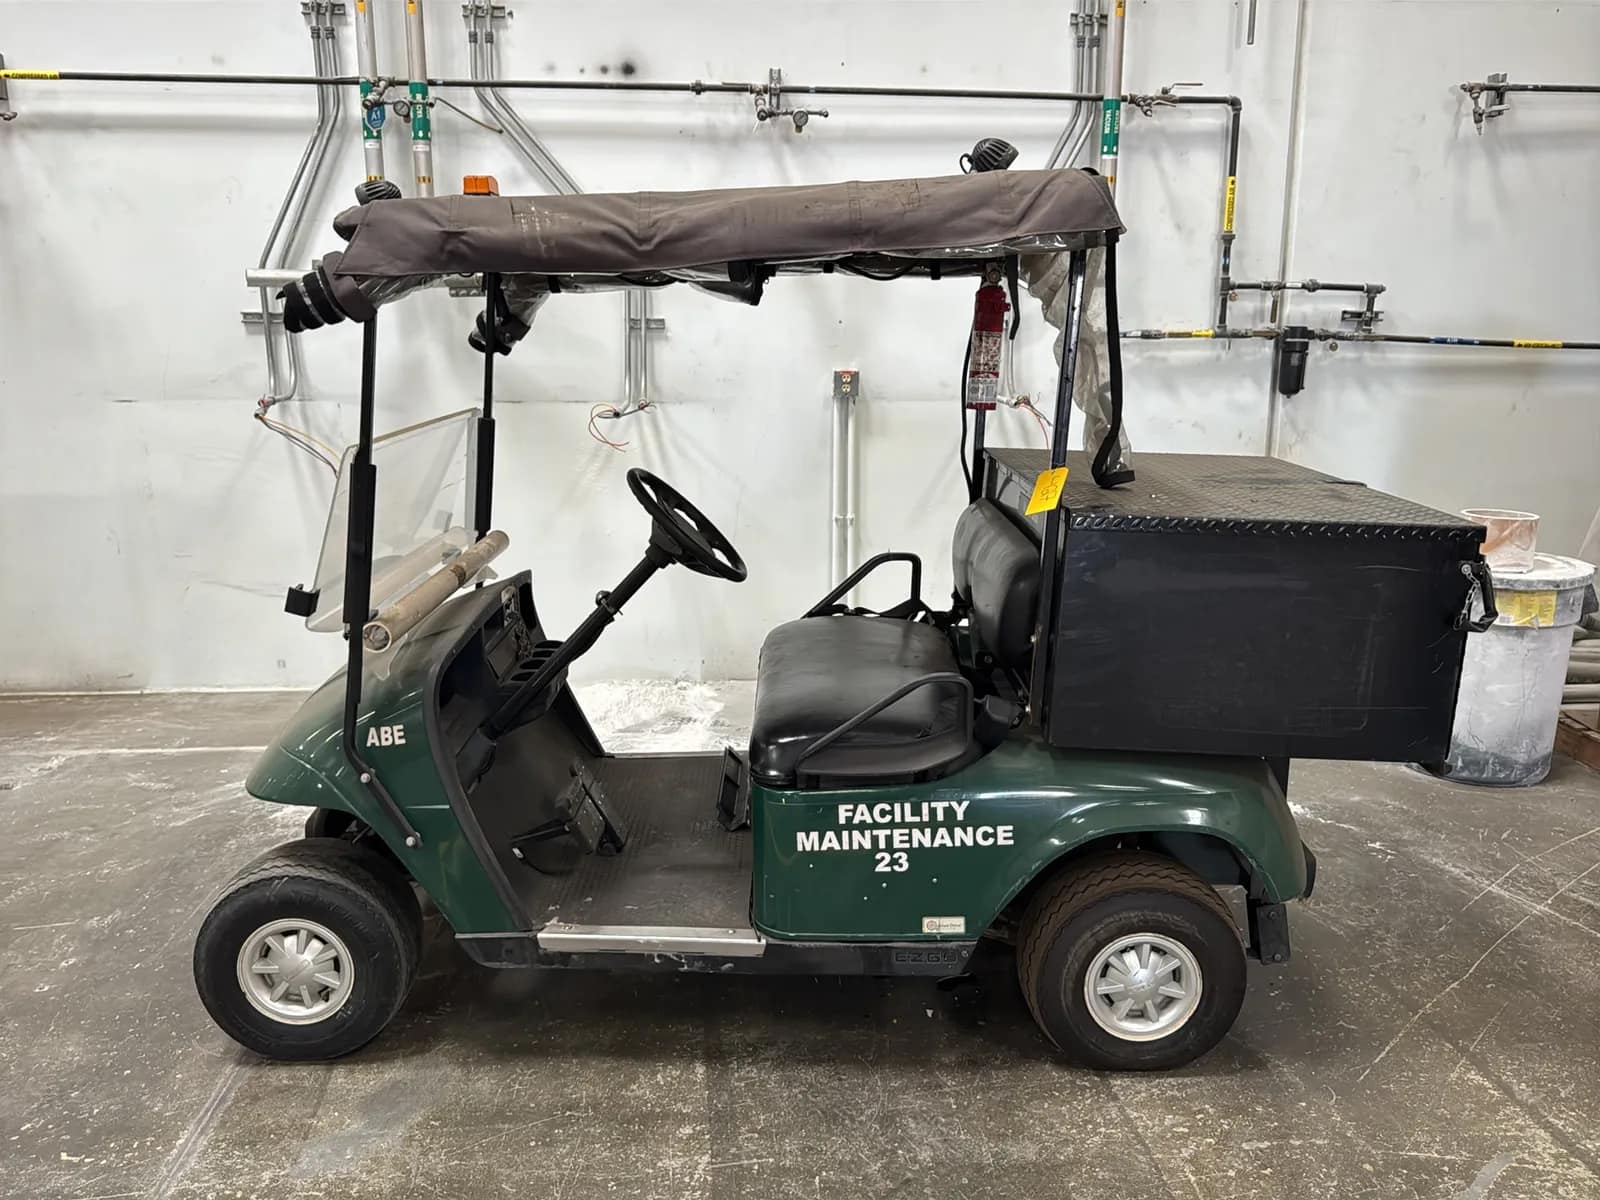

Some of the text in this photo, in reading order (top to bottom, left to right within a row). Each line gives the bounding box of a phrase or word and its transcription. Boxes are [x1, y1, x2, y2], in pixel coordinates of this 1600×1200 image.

[366, 724, 406, 747] ABE
[838, 800, 970, 825] FACILITY
[796, 825, 1015, 851] MAINTENANCE
[874, 852, 909, 873] 23
